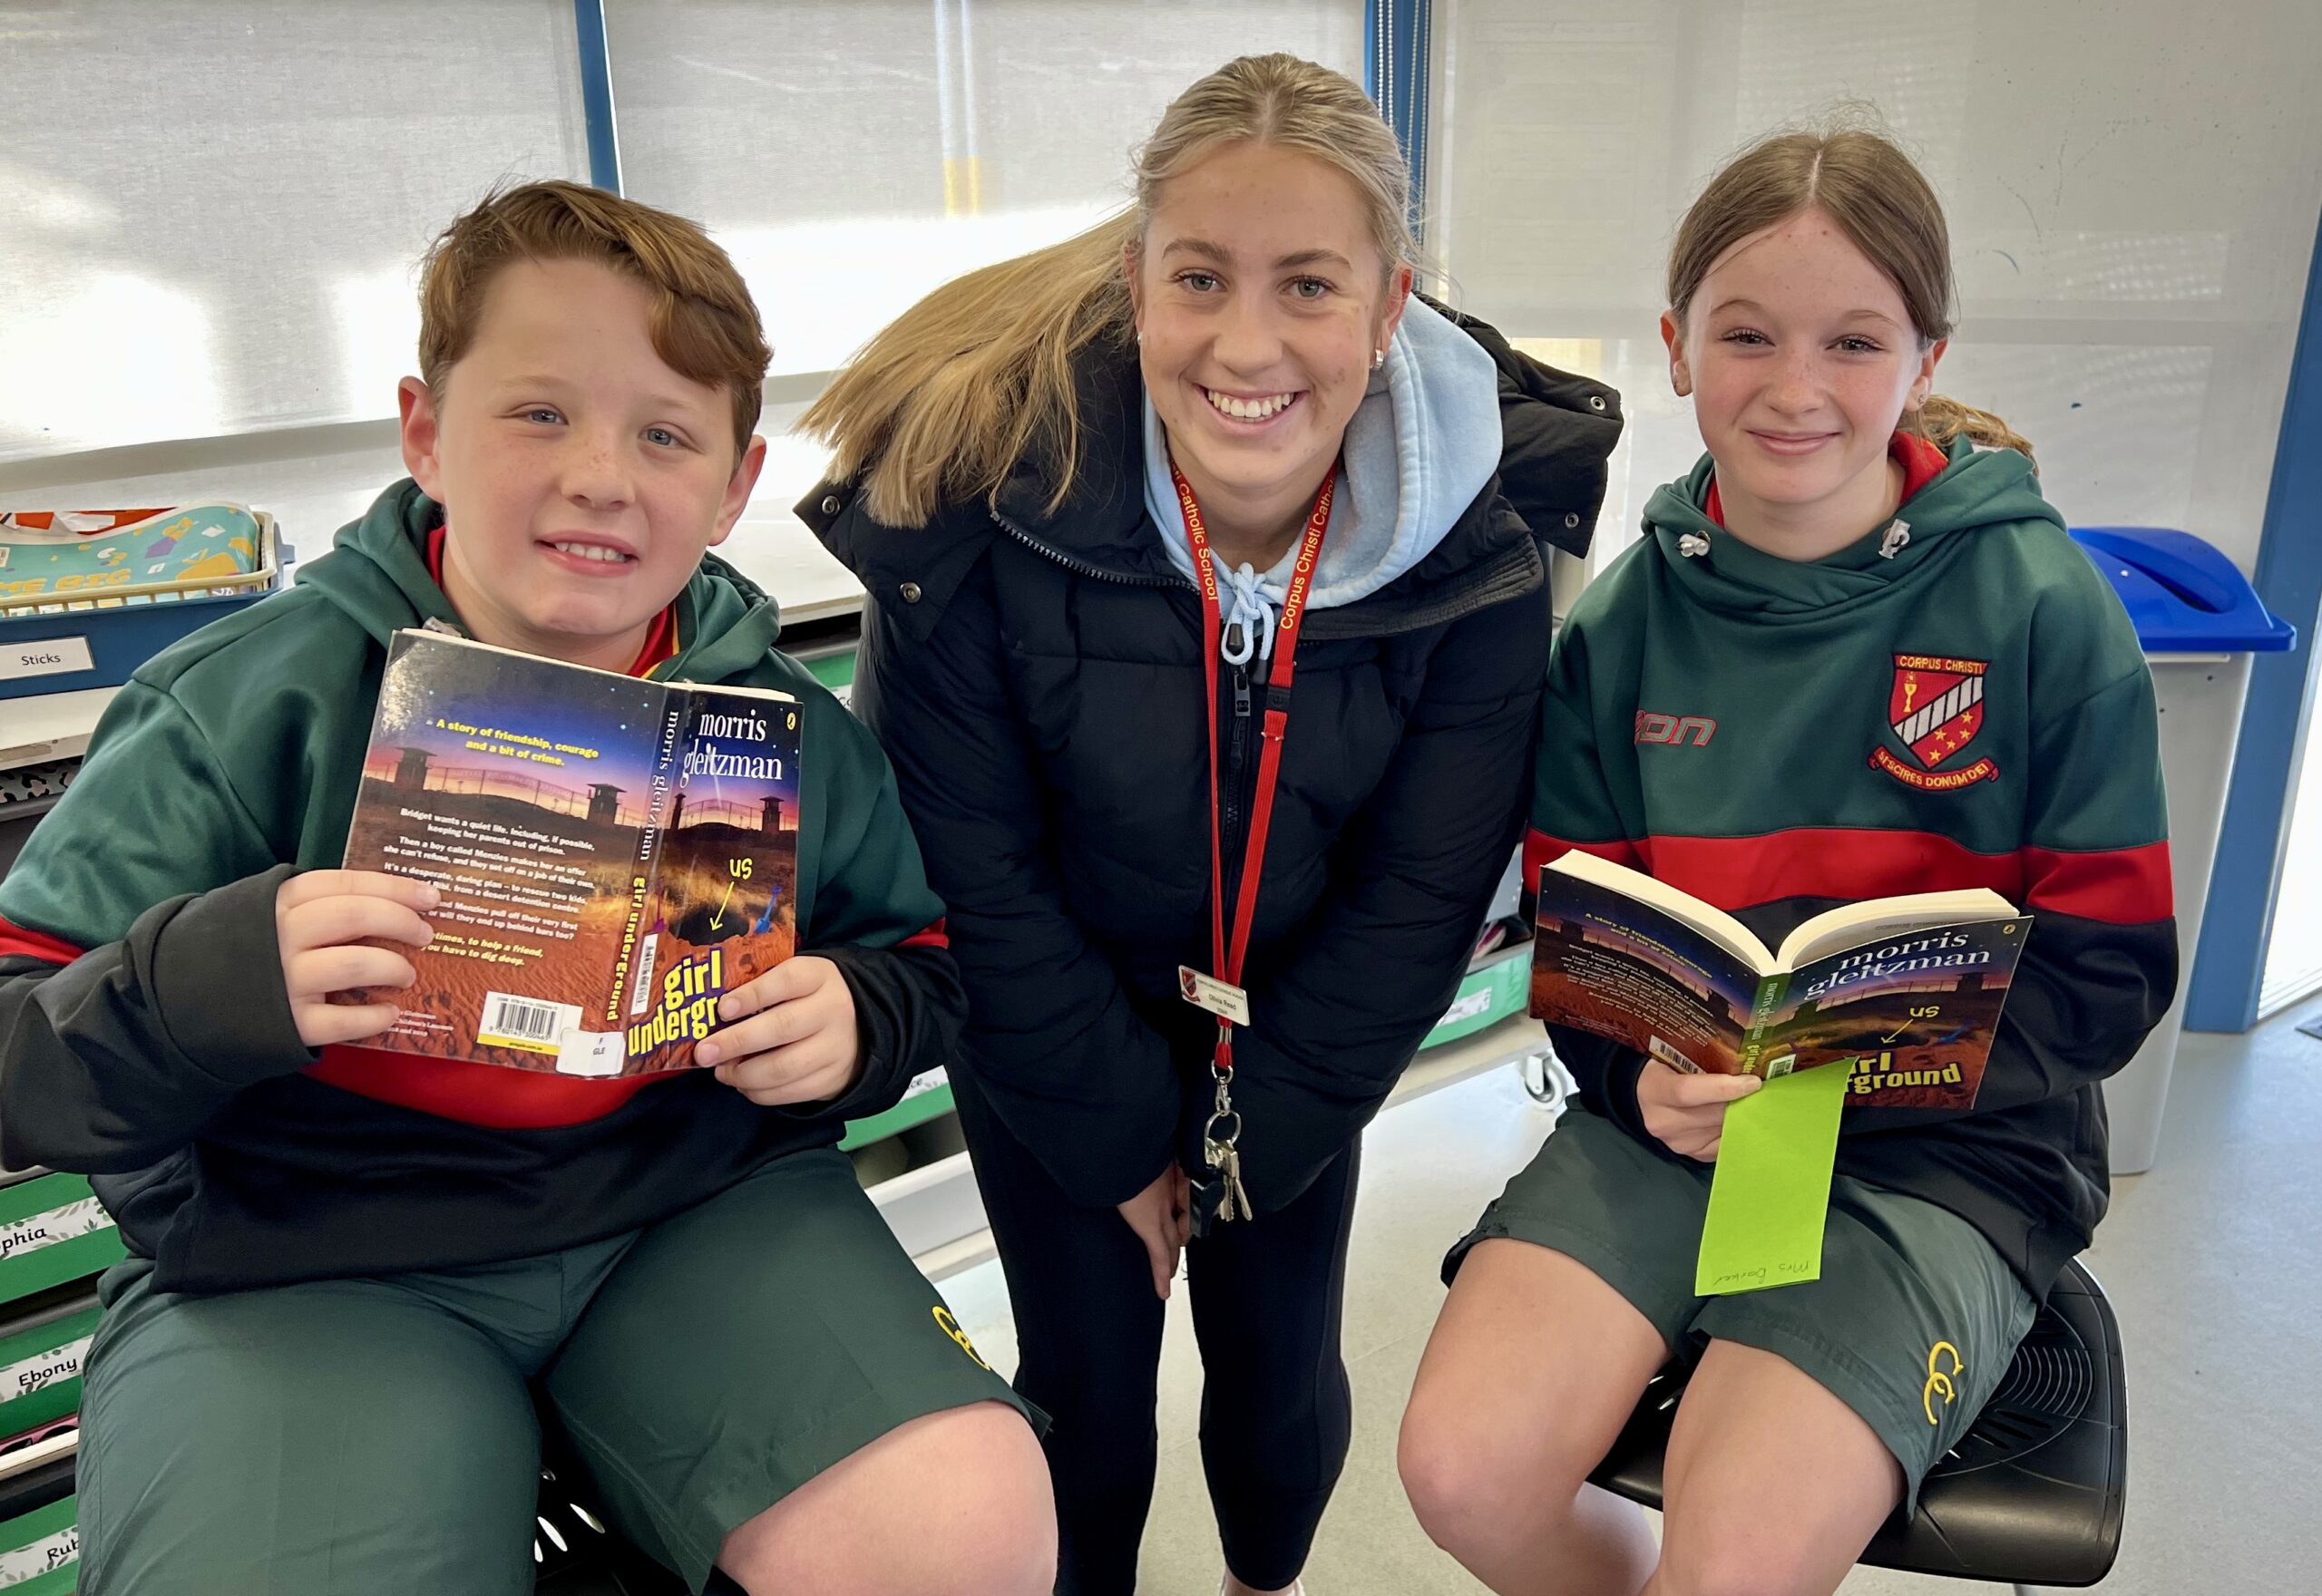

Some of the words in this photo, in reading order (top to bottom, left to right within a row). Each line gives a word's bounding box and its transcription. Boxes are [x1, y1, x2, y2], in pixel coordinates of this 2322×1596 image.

[1179, 483, 1205, 544] Catholic
[1198, 548, 1218, 600] School
[1281, 577, 1306, 629] Corpus
[1297, 528, 1322, 573] Christi
[1313, 479, 1335, 526] Cathol
[22, 653, 62, 666] Sticks
[1899, 656, 1941, 670] CORPUS
[1946, 659, 1983, 675] CHRISTI
[436, 719, 445, 729] A
[448, 722, 478, 736] story
[480, 728, 493, 737] of
[494, 730, 552, 751] friendship,
[555, 744, 600, 759] courage
[659, 711, 679, 771] morris
[698, 709, 767, 742] morris
[466, 740, 487, 751] and
[499, 745, 515, 756] bit
[517, 750, 530, 759] of
[532, 754, 565, 767] crime.
[679, 738, 784, 789] gleitzman
[1887, 760, 1923, 785] SCIRES
[1926, 774, 1968, 787] DONUM
[1967, 763, 1989, 780] DEI
[400, 807, 433, 822] Bridget
[434, 814, 461, 826] wants
[470, 821, 492, 832] quiet
[493, 824, 508, 834] life.
[511, 827, 551, 843] Including,
[551, 834, 559, 843] if
[559, 838, 596, 852] possible,
[640, 774, 669, 861] gleitzman
[399, 836, 421, 847] Then
[430, 842, 446, 852] boy
[446, 845, 473, 857] called
[474, 849, 510, 863] Menzies
[510, 856, 539, 868] makes
[539, 861, 554, 871] her
[554, 863, 566, 872] an
[566, 866, 588, 876] offer
[427, 823, 463, 838] keeping
[463, 831, 477, 840] her
[479, 833, 512, 847] parents
[512, 840, 528, 849] out
[528, 842, 539, 851] of
[539, 844, 566, 856] prison.
[383, 845, 400, 854] she
[400, 847, 423, 859] can't
[423, 852, 452, 864] refuse,
[453, 856, 470, 865] and
[470, 859, 488, 871] they
[489, 863, 502, 872] set
[503, 865, 515, 874] off
[533, 871, 548, 881] job
[558, 876, 577, 886] their
[577, 880, 596, 889] own.
[385, 862, 399, 872] It's
[408, 867, 454, 881] desperate,
[455, 875, 483, 889] daring
[484, 880, 503, 890] plan
[512, 884, 522, 892] to
[522, 887, 551, 898] rescue
[551, 891, 568, 900] two
[729, 857, 754, 880] us
[454, 885, 474, 896] from
[483, 890, 511, 901] desert
[512, 895, 551, 909] detention
[551, 903, 581, 914] centre.
[633, 876, 646, 909] girl
[428, 910, 439, 918] or
[439, 910, 455, 920] will
[456, 913, 476, 925] they
[476, 918, 493, 927] end
[494, 920, 506, 929] up
[506, 920, 535, 933] behind
[535, 927, 555, 938] bars
[555, 930, 575, 941] too?
[454, 902, 490, 916] Menzies
[490, 909, 508, 919] pull
[508, 912, 521, 920] off
[521, 914, 542, 924] their
[542, 919, 561, 929] very
[561, 921, 579, 931] first
[435, 932, 466, 945] times,
[468, 938, 481, 947] to
[481, 939, 502, 952] help
[502, 944, 511, 952] a
[512, 945, 544, 959] friend,
[442, 945, 466, 958] have
[468, 949, 480, 958] to
[481, 951, 498, 962] dig
[498, 955, 525, 967] deep.
[1839, 931, 1969, 971] morris
[606, 912, 639, 1021] underground
[664, 949, 722, 1011] girl
[1804, 950, 1990, 1001] gleitzman
[628, 997, 718, 1057] undergr
[1909, 1005, 1941, 1017] us
[592, 1046, 606, 1056] GLE
[1742, 1056, 1756, 1074] under
[0, 1228, 47, 1253] phia
[18, 1358, 78, 1387] Ebony
[47, 1538, 79, 1560] Rub
